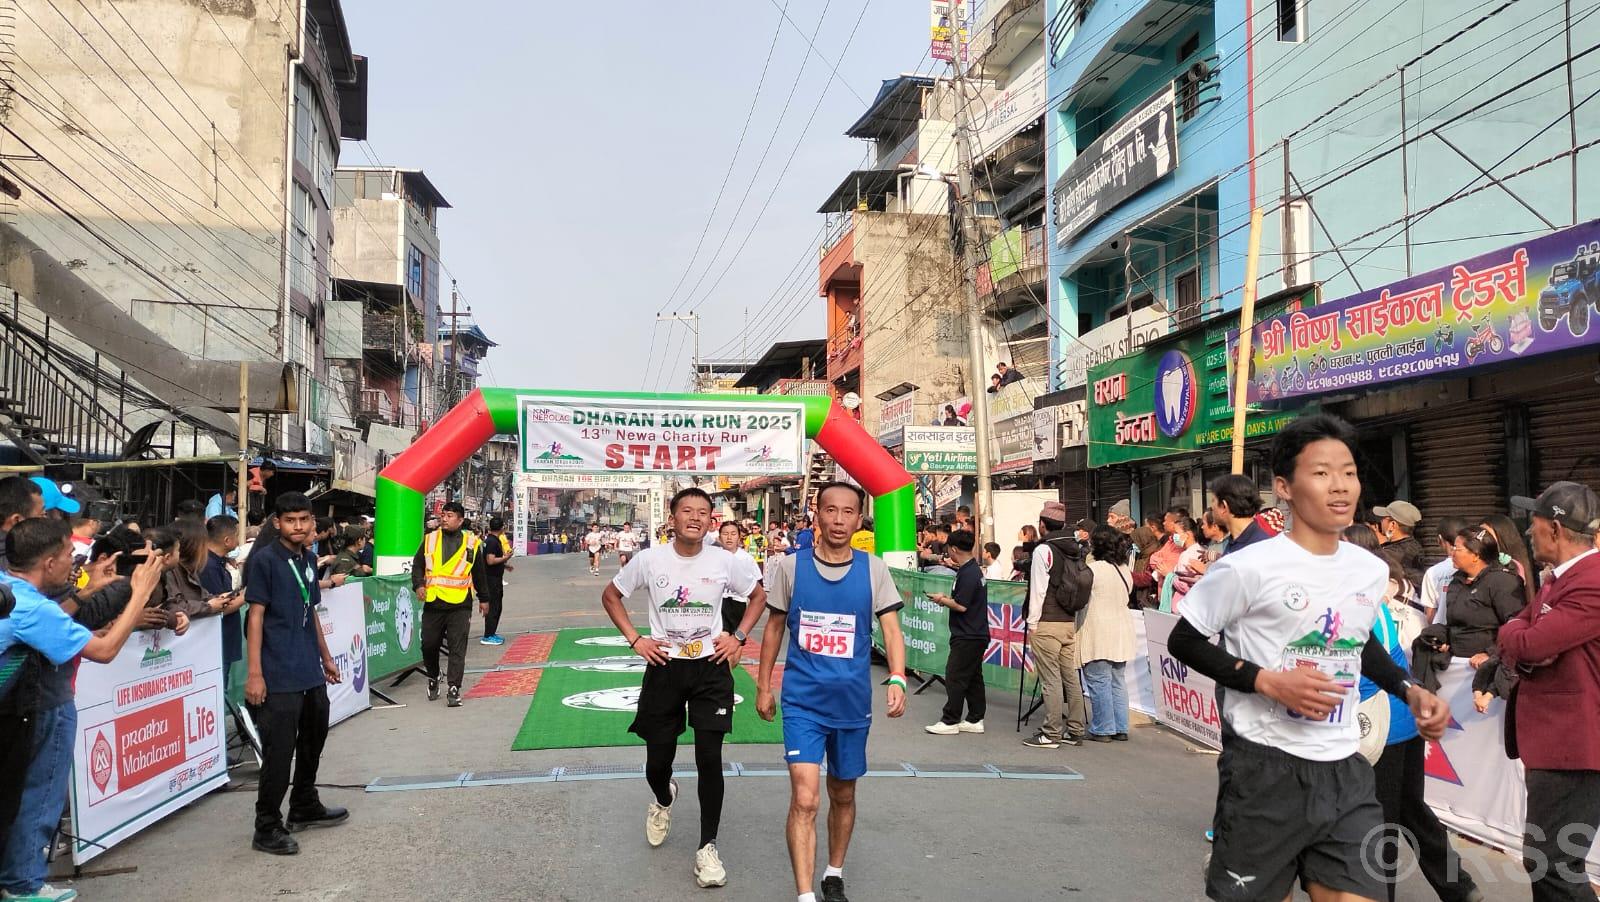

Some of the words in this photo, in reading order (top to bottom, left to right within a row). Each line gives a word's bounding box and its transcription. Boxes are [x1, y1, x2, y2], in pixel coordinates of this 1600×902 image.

[1262, 319, 1286, 361] श्री
[1290, 311, 1341, 352] विष्णु
[1345, 289, 1445, 340] साईकल
[1450, 248, 1530, 323] ट्रेडर्स
[1206, 352, 1227, 367] 025-57
[1367, 345, 1393, 365] पुतली
[1396, 338, 1426, 357] लाईन
[1208, 378, 1228, 393] info@
[572, 410, 654, 427] DHARAN
[660, 413, 696, 428] 10K
[702, 414, 741, 429] RUN
[747, 415, 792, 430] 2025
[1221, 427, 1235, 440] OPE
[1247, 421, 1266, 435] DAYS
[1267, 421, 1273, 431] A
[581, 428, 610, 440] 13th
[616, 429, 656, 441] Newa
[662, 430, 715, 444] Charity
[721, 431, 748, 443] Run
[955, 431, 976, 443] इन्ट
[605, 443, 722, 470] START
[923, 453, 943, 462] Yeti
[516, 492, 524, 539] WELCOME
[373, 598, 391, 615] Nepal
[805, 633, 847, 655] 1345
[1160, 655, 1188, 683] KNP
[117, 689, 131, 706] LIFE
[131, 677, 168, 701] INSURANCE
[168, 669, 192, 691] PARTNER
[1162, 681, 1221, 728] NEROLA
[188, 706, 215, 744] Life
[122, 736, 181, 777] Mahalaxmi
